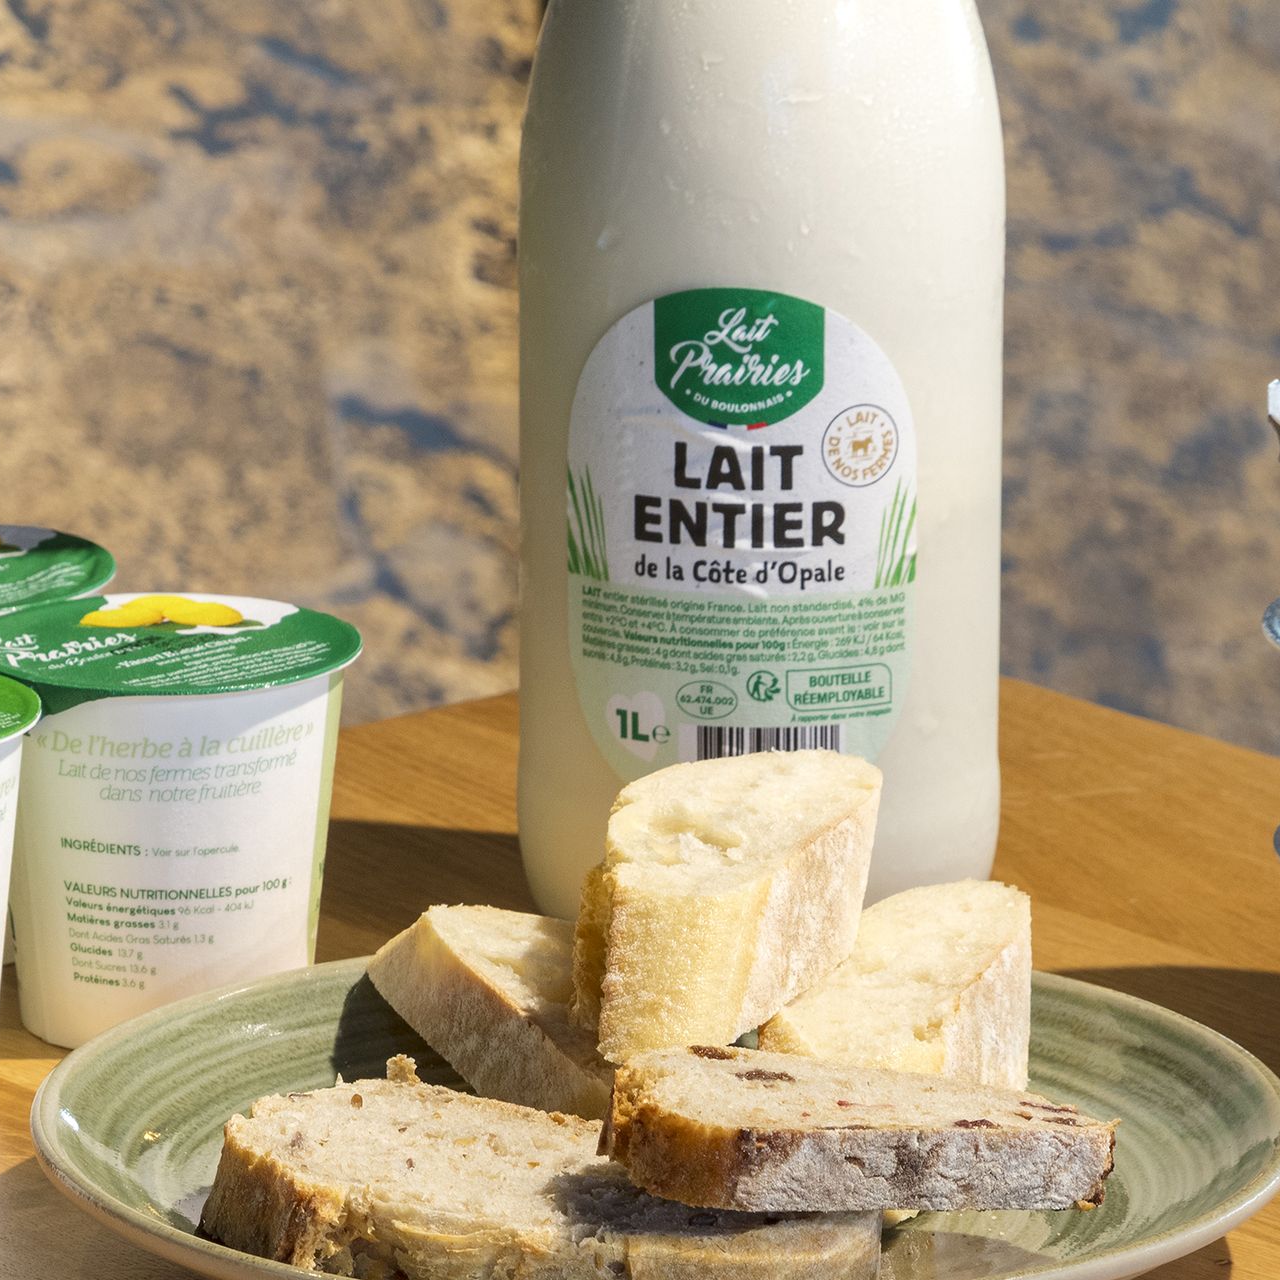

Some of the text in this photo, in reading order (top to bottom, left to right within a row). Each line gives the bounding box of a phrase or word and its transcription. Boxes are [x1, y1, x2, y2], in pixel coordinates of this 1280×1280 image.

[704, 307, 780, 354] Lait
[669, 340, 811, 390] Prairies
[693, 393, 785, 414] DU BOULONNAIS
[846, 411, 879, 428] LAIT
[674, 441, 805, 491] LAIT
[828, 430, 894, 481] DE NOS FERMES
[634, 494, 847, 549] ENTIER
[634, 553, 659, 579] de
[666, 556, 685, 581] la
[692, 560, 748, 584] Côte
[809, 671, 872, 687] BOUTEILLE
[699, 704, 715, 716] UE
[793, 685, 886, 706] RÉEMPLOYABLE
[616, 708, 651, 743] 1L
[50, 730, 82, 755] De
[178, 737, 191, 759] à
[200, 735, 221, 757] la
[58, 749, 298, 786] Lait de nos fermes transformé
[99, 784, 142, 802] dans
[148, 786, 197, 803] notre
[60, 837, 141, 858] INGRÉDIENTS
[63, 879, 260, 902] VALEURS NUTRITIONNELLES pour
